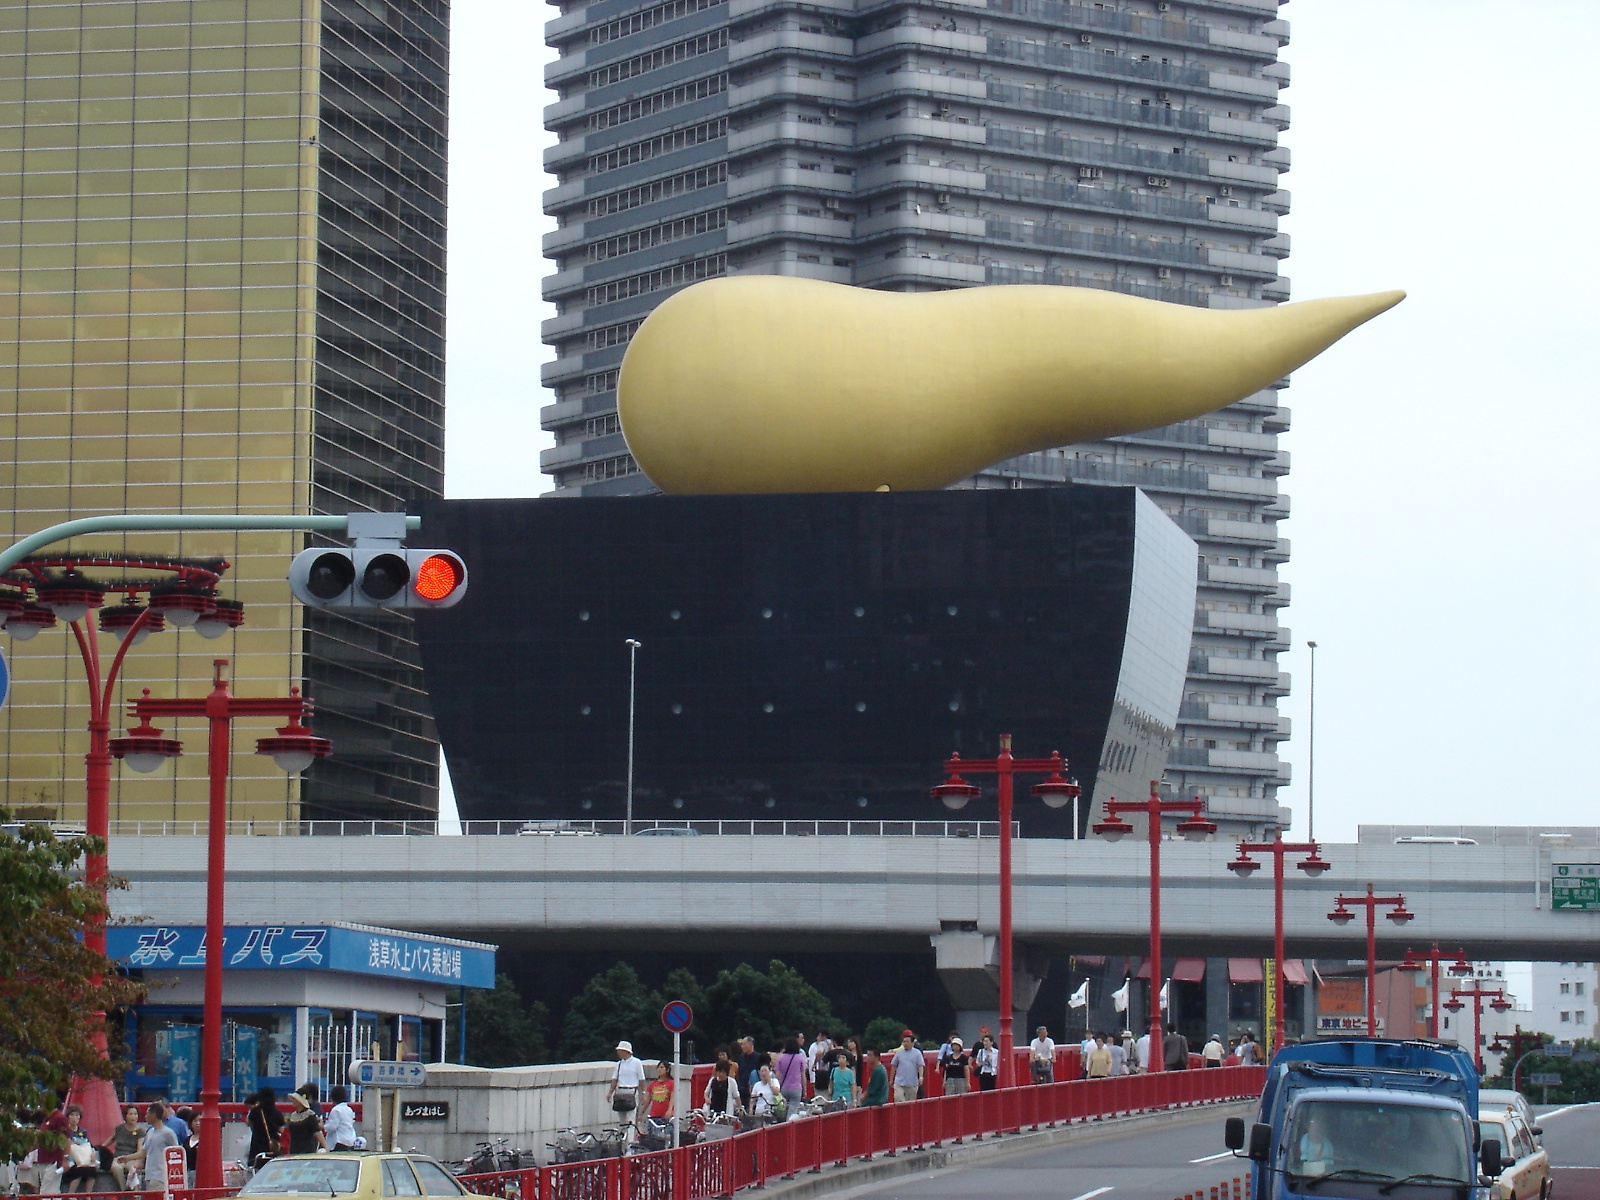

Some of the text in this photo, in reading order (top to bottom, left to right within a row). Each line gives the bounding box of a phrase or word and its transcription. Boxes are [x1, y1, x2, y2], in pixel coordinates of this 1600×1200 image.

[368, 937, 461, 979] 浅草水上バス乗船場
[404, 1105, 446, 1117] あづまはし
